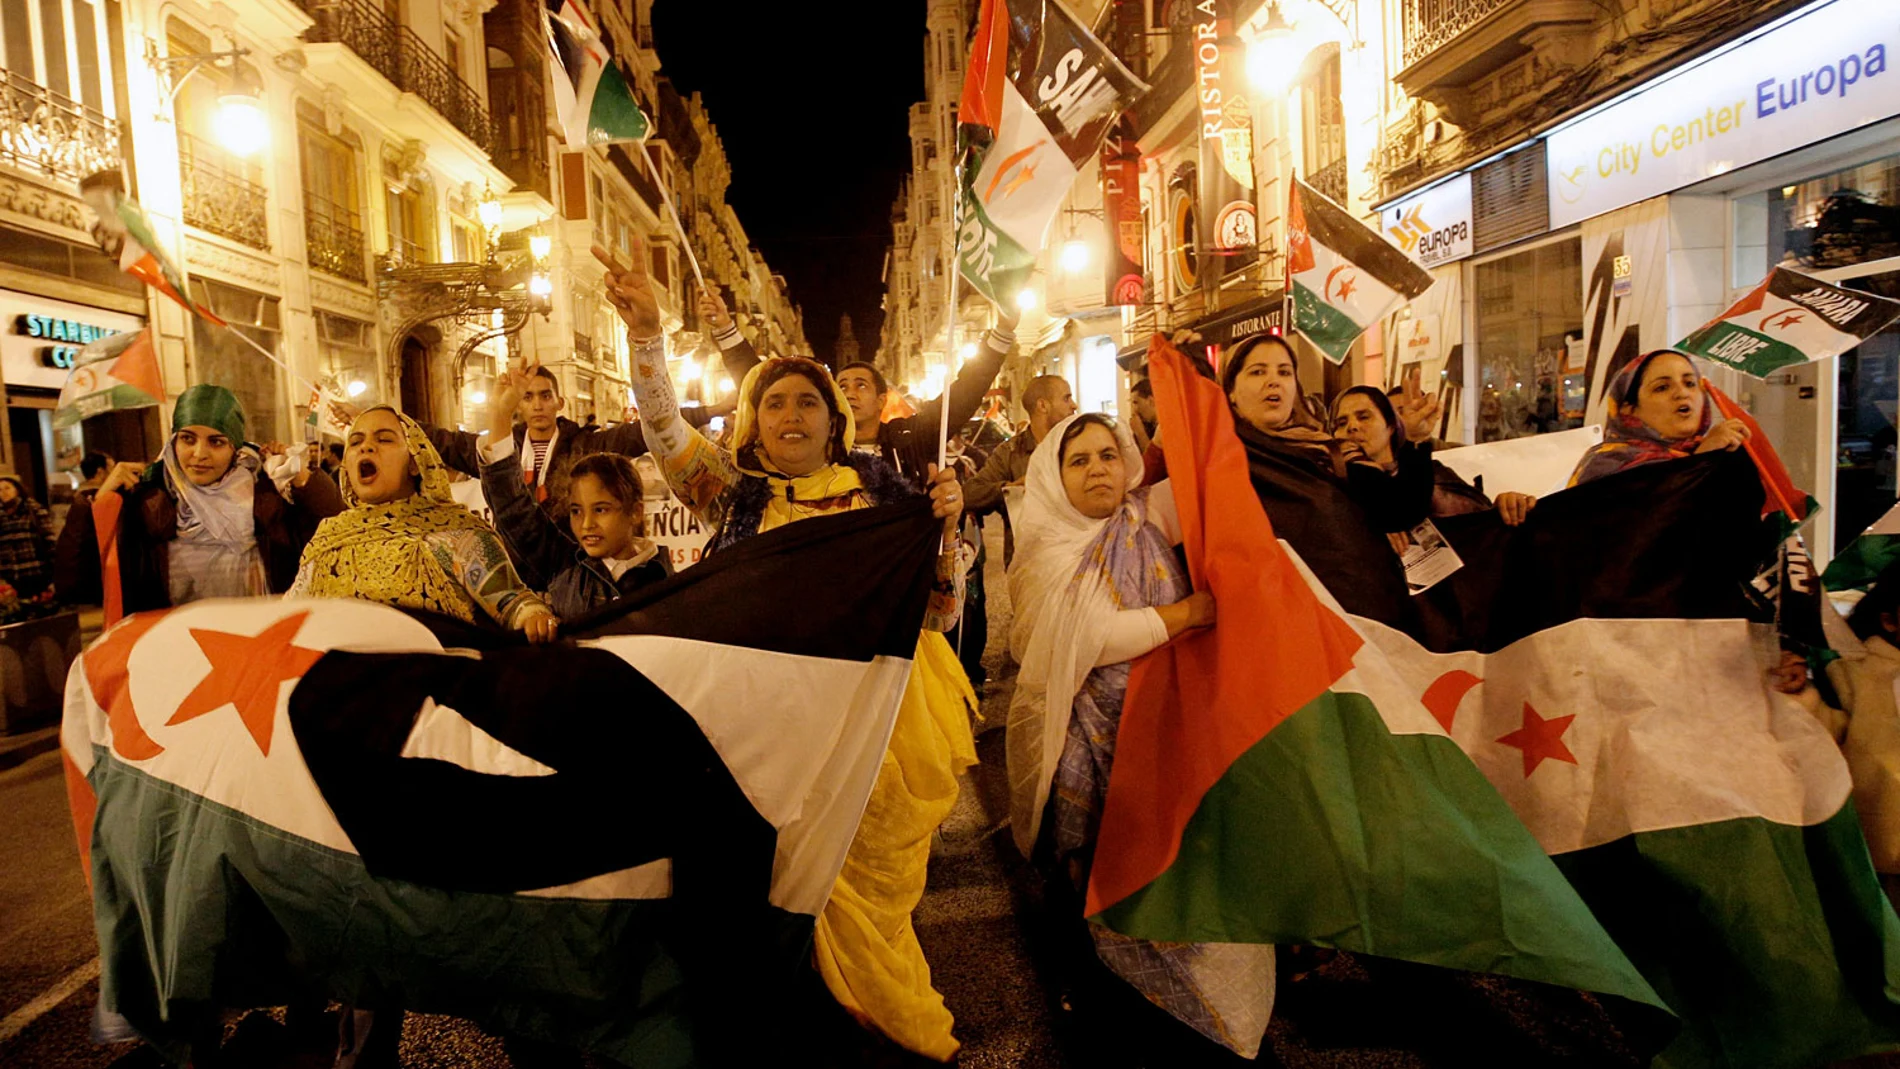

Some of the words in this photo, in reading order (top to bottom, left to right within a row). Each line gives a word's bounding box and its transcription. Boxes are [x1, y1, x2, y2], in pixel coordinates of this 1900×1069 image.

[1597, 141, 1643, 178] City
[1650, 99, 1746, 158] Center
[1756, 43, 1887, 119] Europa
[1104, 134, 1124, 196] PIZ
[26, 312, 122, 344] STARBU
[1231, 310, 1280, 338] RISTORANTE
[1707, 331, 1770, 363] LIBRE
